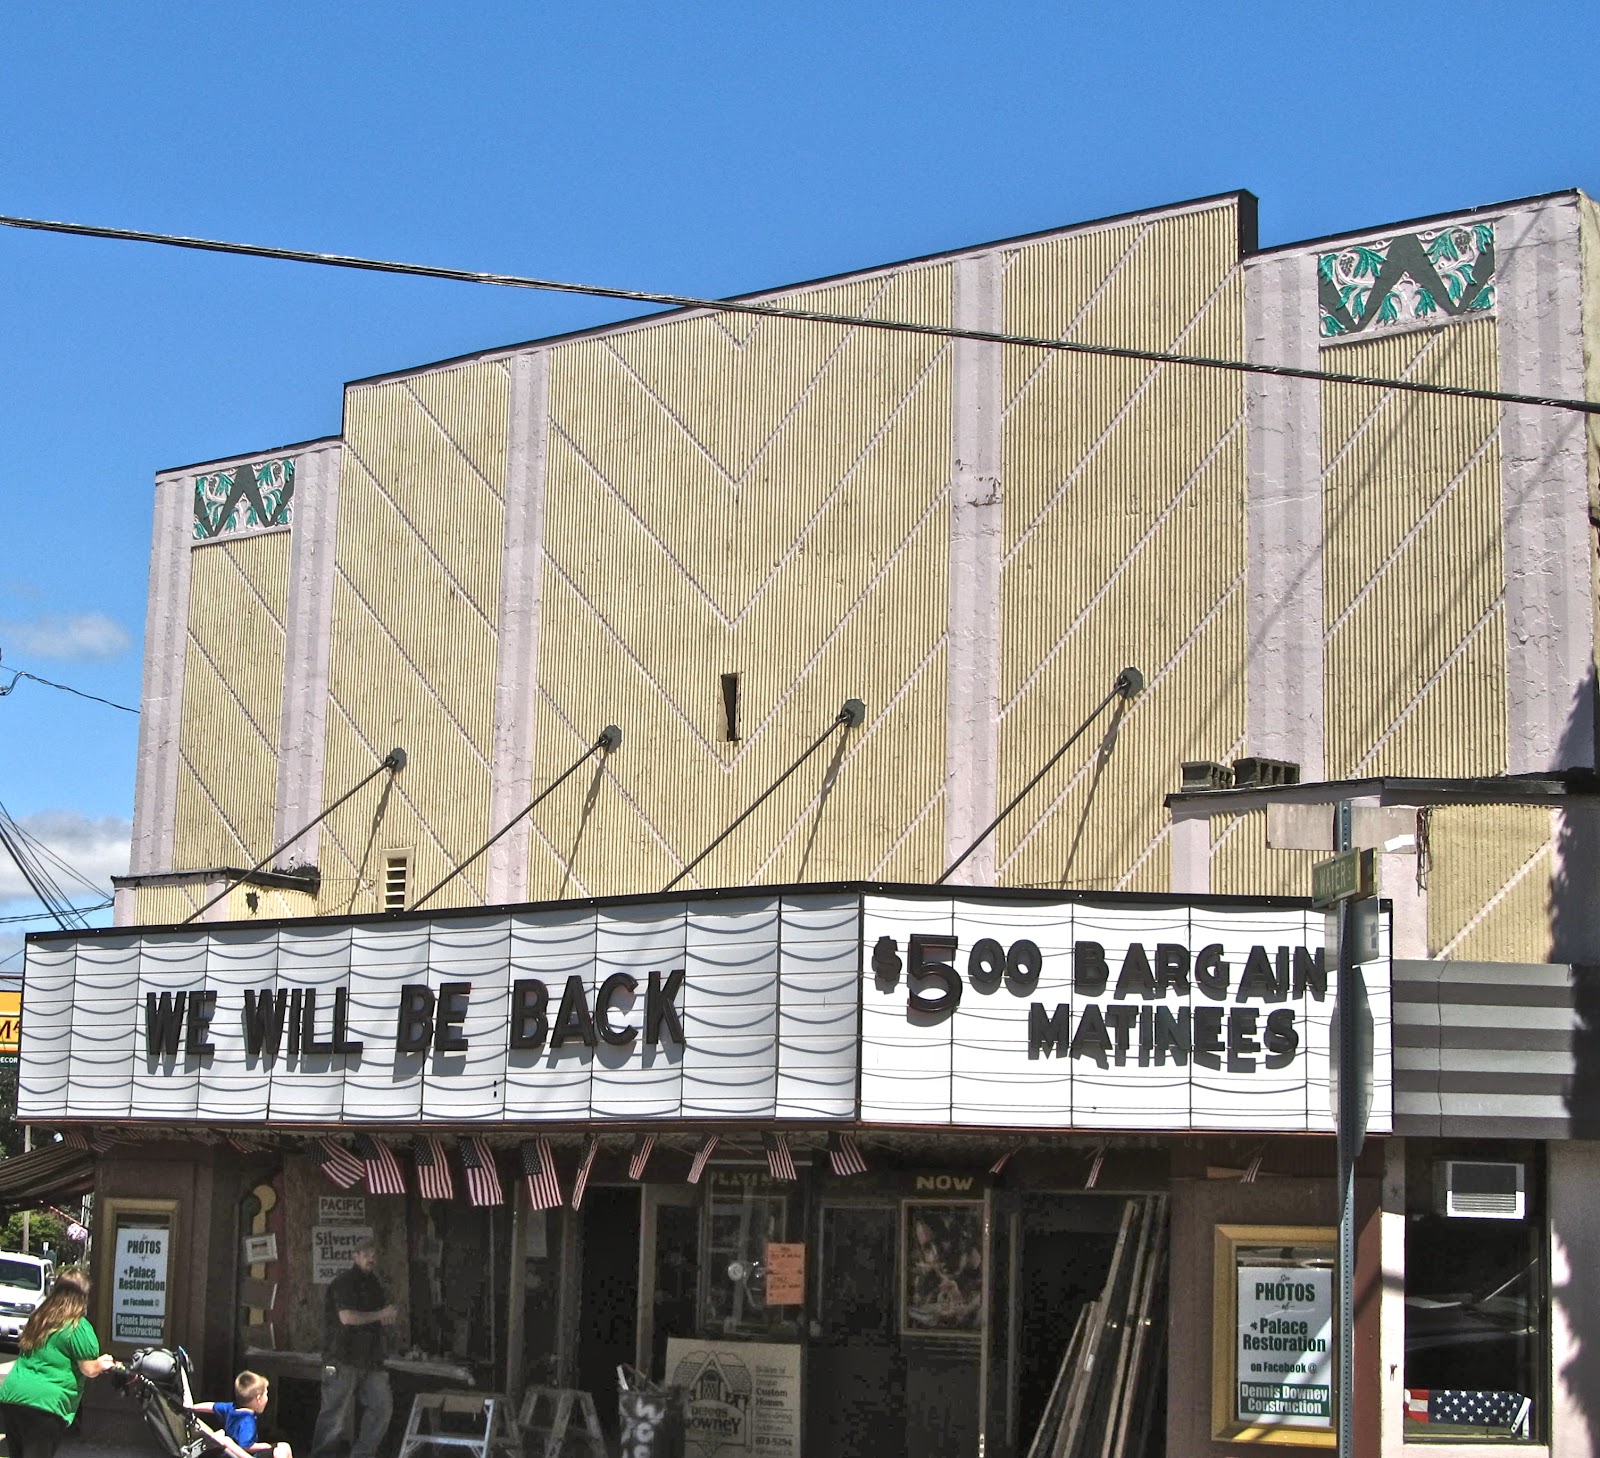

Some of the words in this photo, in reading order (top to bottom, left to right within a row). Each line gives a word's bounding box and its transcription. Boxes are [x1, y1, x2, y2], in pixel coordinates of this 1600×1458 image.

[1319, 862, 1346, 896] WATER
[1074, 940, 1327, 994] BARGAIN
[146, 990, 217, 1056] WE
[244, 986, 363, 1056] WILL
[400, 981, 472, 1053] BE
[510, 969, 685, 1050] BACK
[1029, 1002, 1299, 1057] MATINEES
[0, 1056, 18, 1064] ECOR
[711, 1171, 789, 1186] PLAYIN
[916, 1175, 974, 1191] NOW
[315, 1232, 364, 1246] Silvert
[127, 1240, 162, 1255] PHOTOS
[129, 1265, 156, 1280] Palace
[119, 1278, 166, 1292] Restoration
[1255, 1282, 1316, 1302] PHOTOS
[116, 1314, 138, 1326] Dennis
[139, 1316, 165, 1329] Downey
[1260, 1317, 1308, 1335] Palace
[120, 1325, 162, 1338] Construction
[1243, 1333, 1327, 1353] Restoration
[1250, 1362, 1262, 1373] on
[1263, 1361, 1307, 1374] Facebook
[756, 1388, 788, 1398] Custom
[1241, 1383, 1281, 1399] Dennis
[1282, 1385, 1328, 1402] Downey
[1247, 1397, 1323, 1415] Construction
